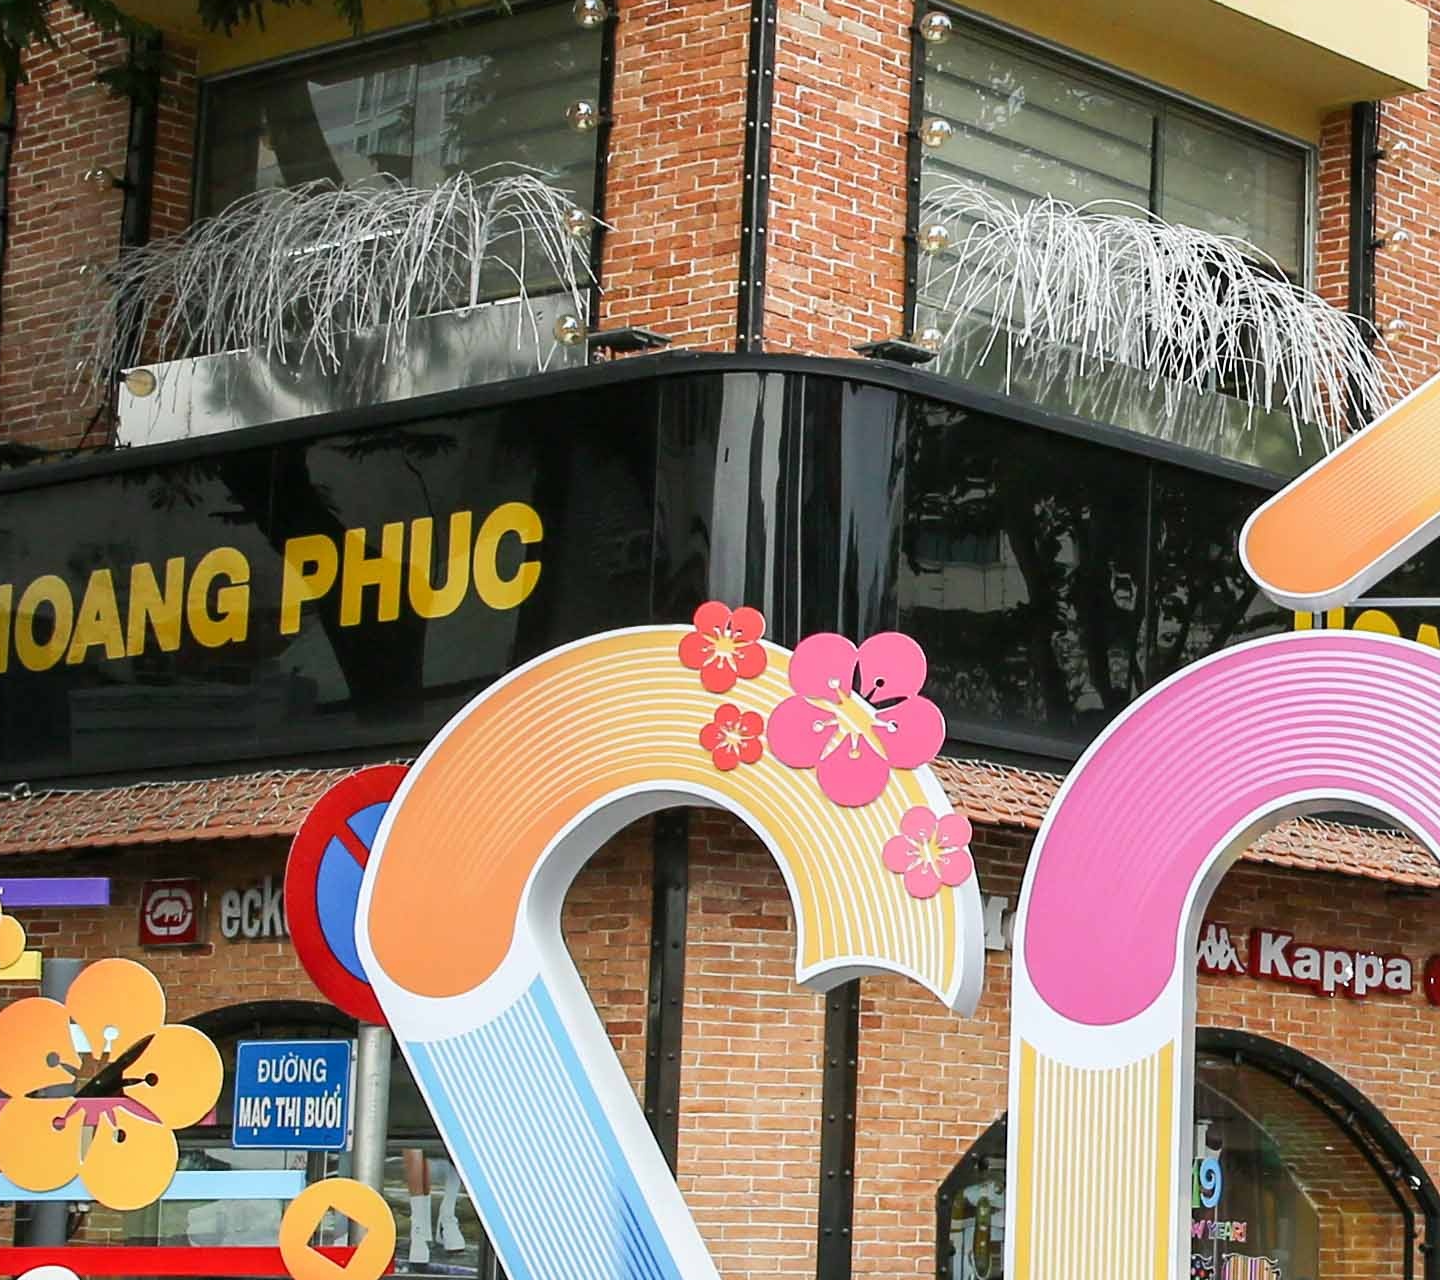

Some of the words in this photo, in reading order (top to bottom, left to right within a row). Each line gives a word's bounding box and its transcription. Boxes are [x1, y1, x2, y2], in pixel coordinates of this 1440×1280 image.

[280, 501, 547, 634] PHUC
[220, 874, 288, 938] eck
[1260, 931, 1412, 994] Kappa
[258, 1052, 327, 1083] ĐƯỜNG
[239, 1096, 271, 1135] MẠC
[276, 1096, 302, 1135] THỊ
[305, 1084, 342, 1128] BƯỞI
